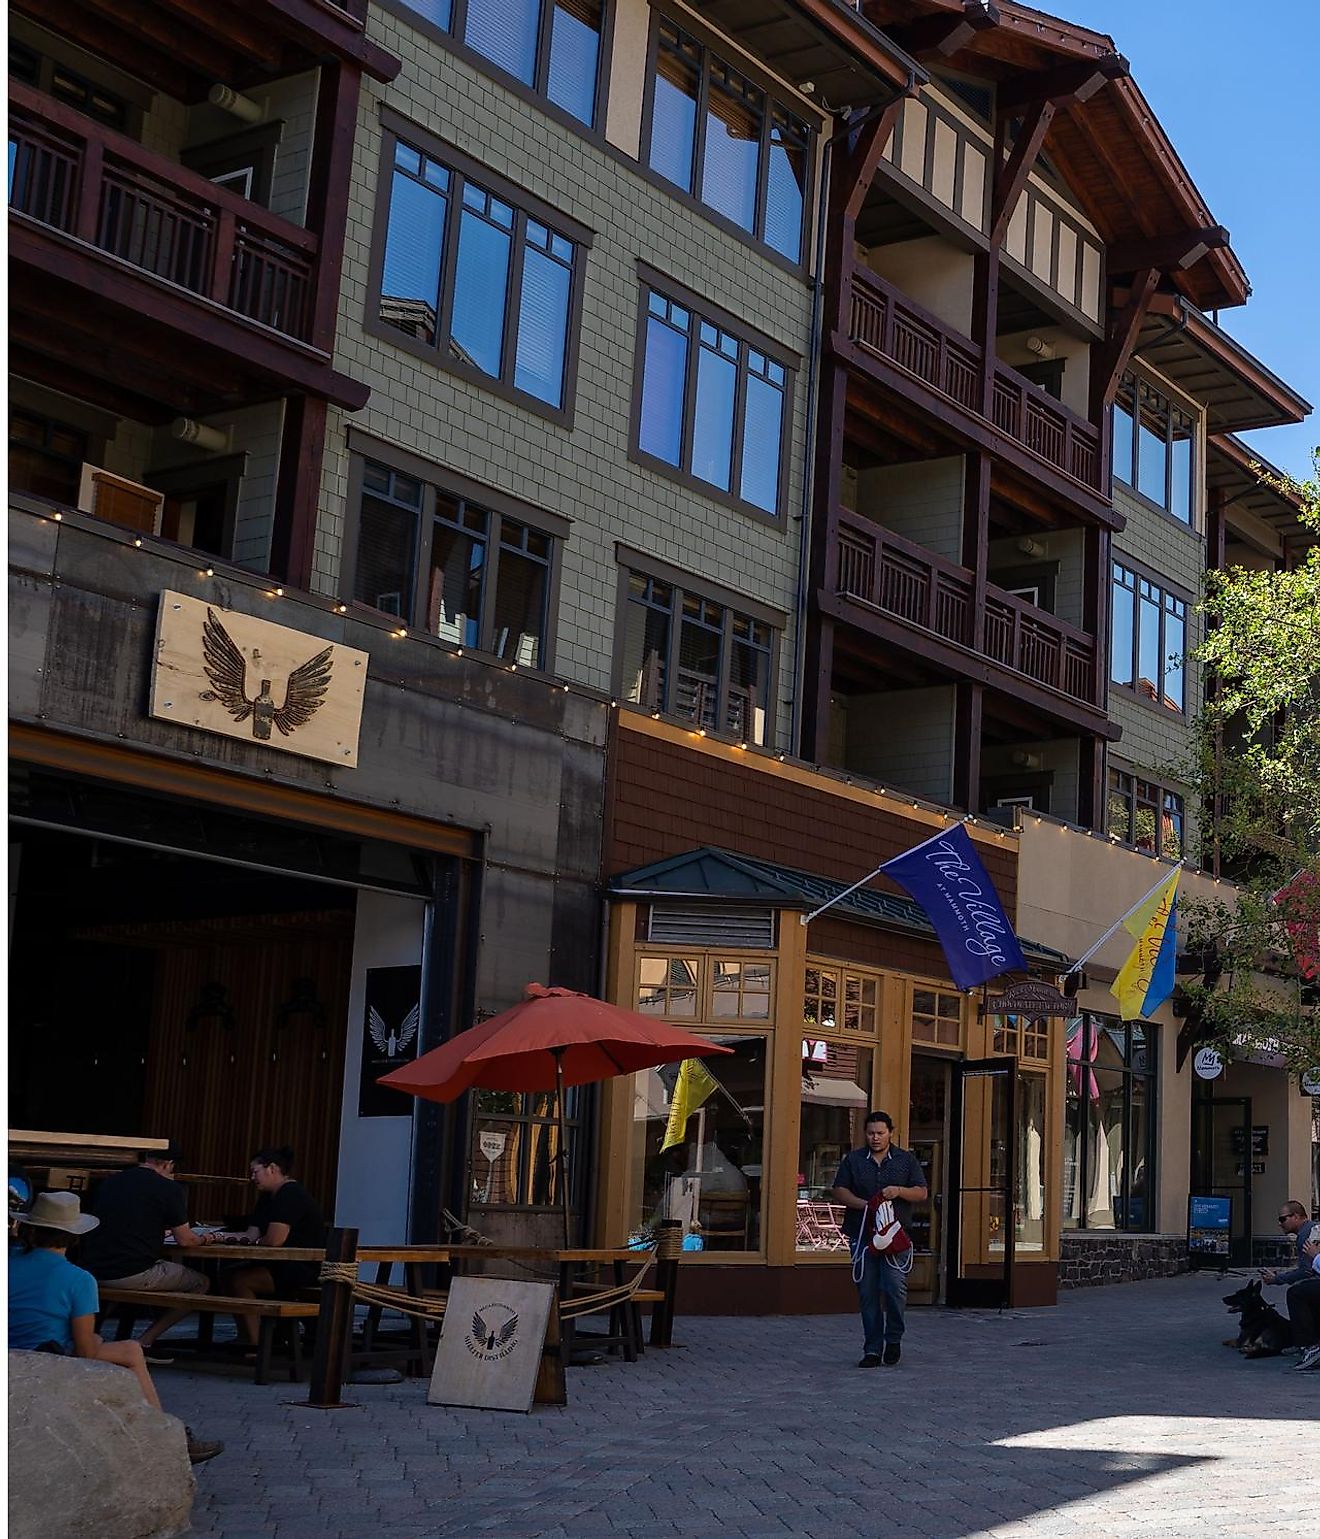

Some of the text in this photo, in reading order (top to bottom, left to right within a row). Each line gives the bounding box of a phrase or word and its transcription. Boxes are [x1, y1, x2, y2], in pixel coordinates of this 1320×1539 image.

[926, 840, 1007, 967] The Village
[936, 883, 970, 932] AT MAMMOTH
